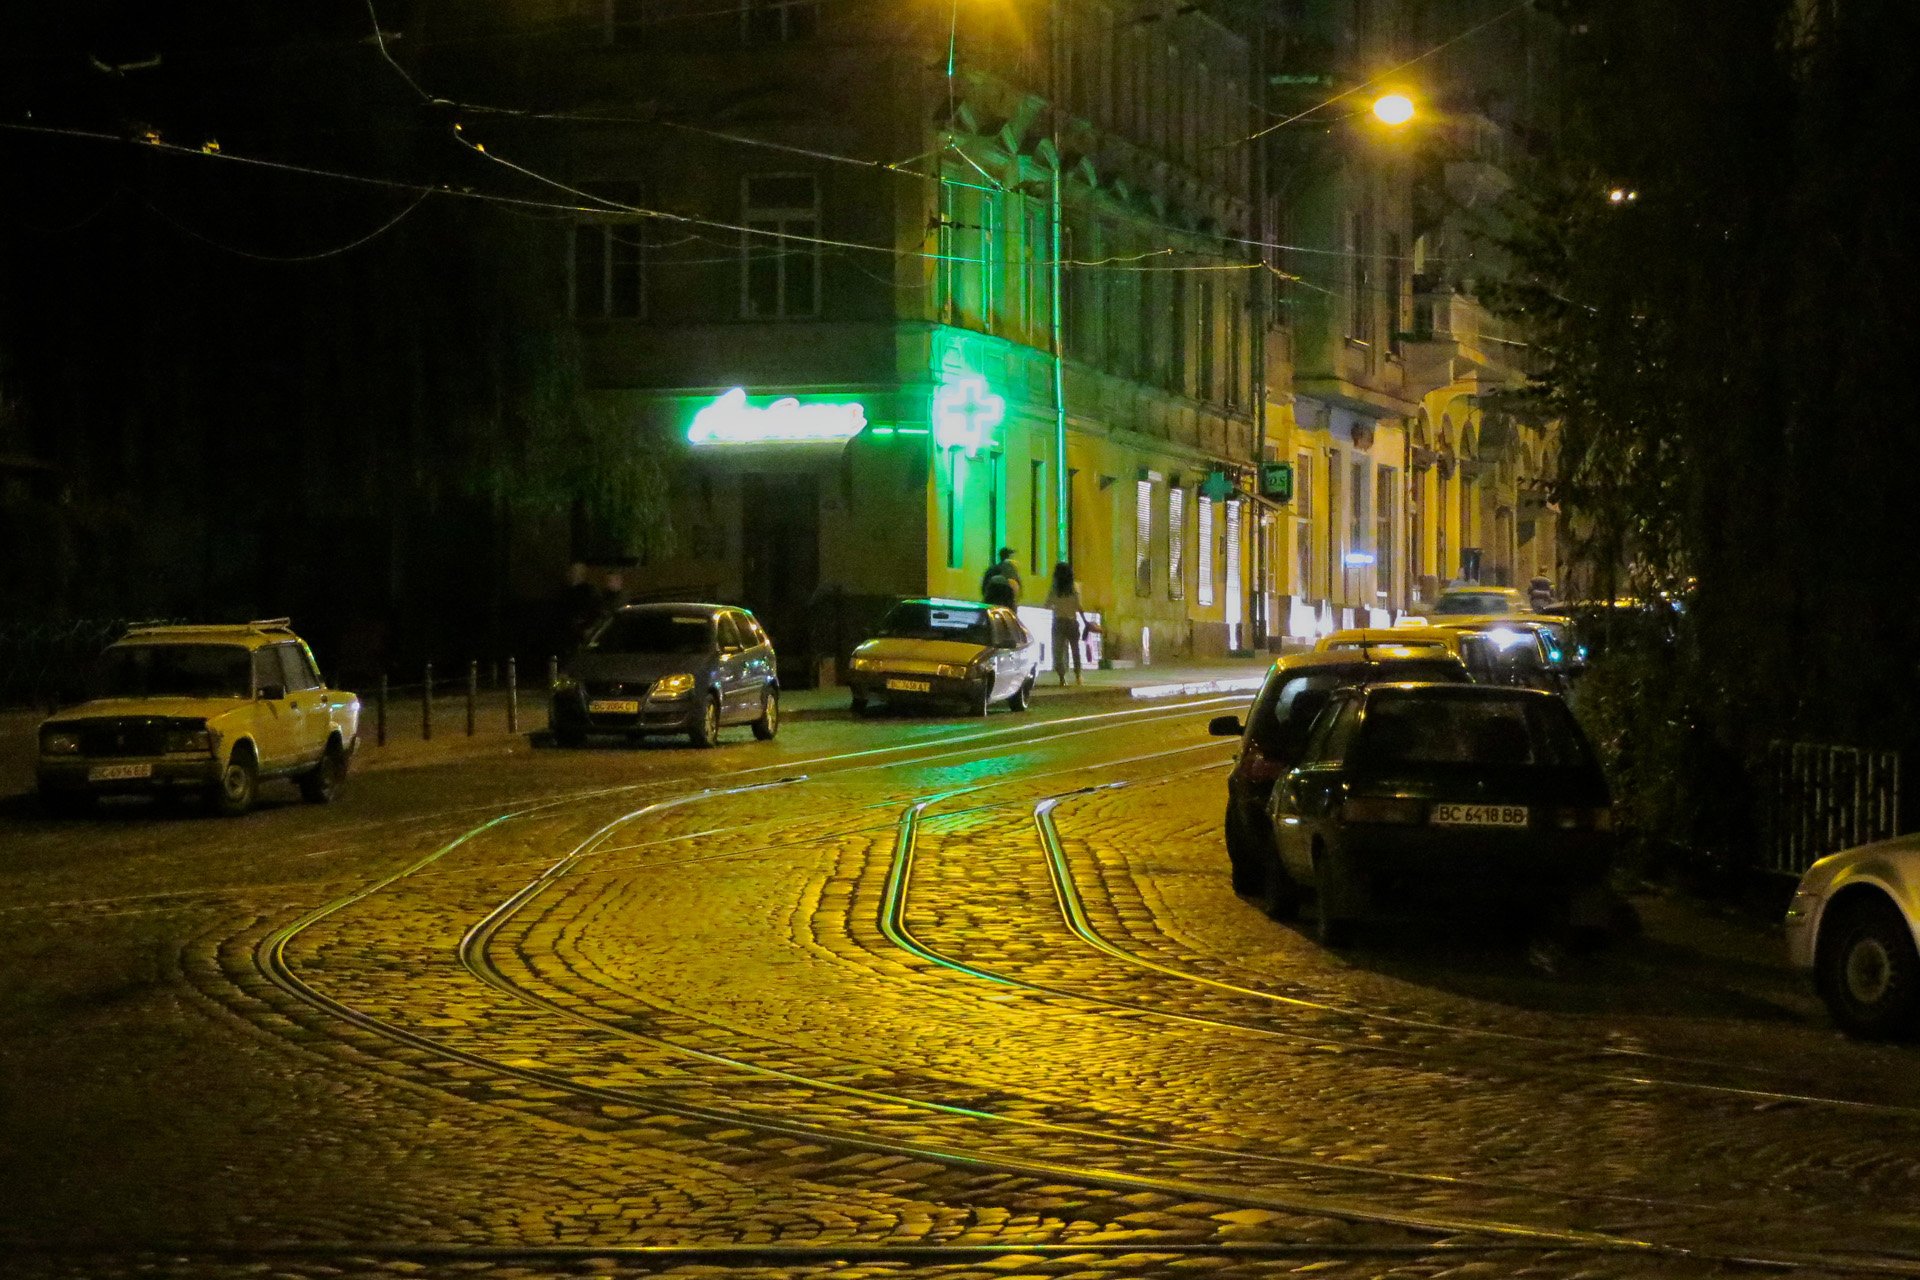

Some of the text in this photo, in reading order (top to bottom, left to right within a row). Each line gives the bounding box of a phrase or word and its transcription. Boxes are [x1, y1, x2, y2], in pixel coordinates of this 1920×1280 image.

[1439, 806, 1525, 824] BC 6418 BB
